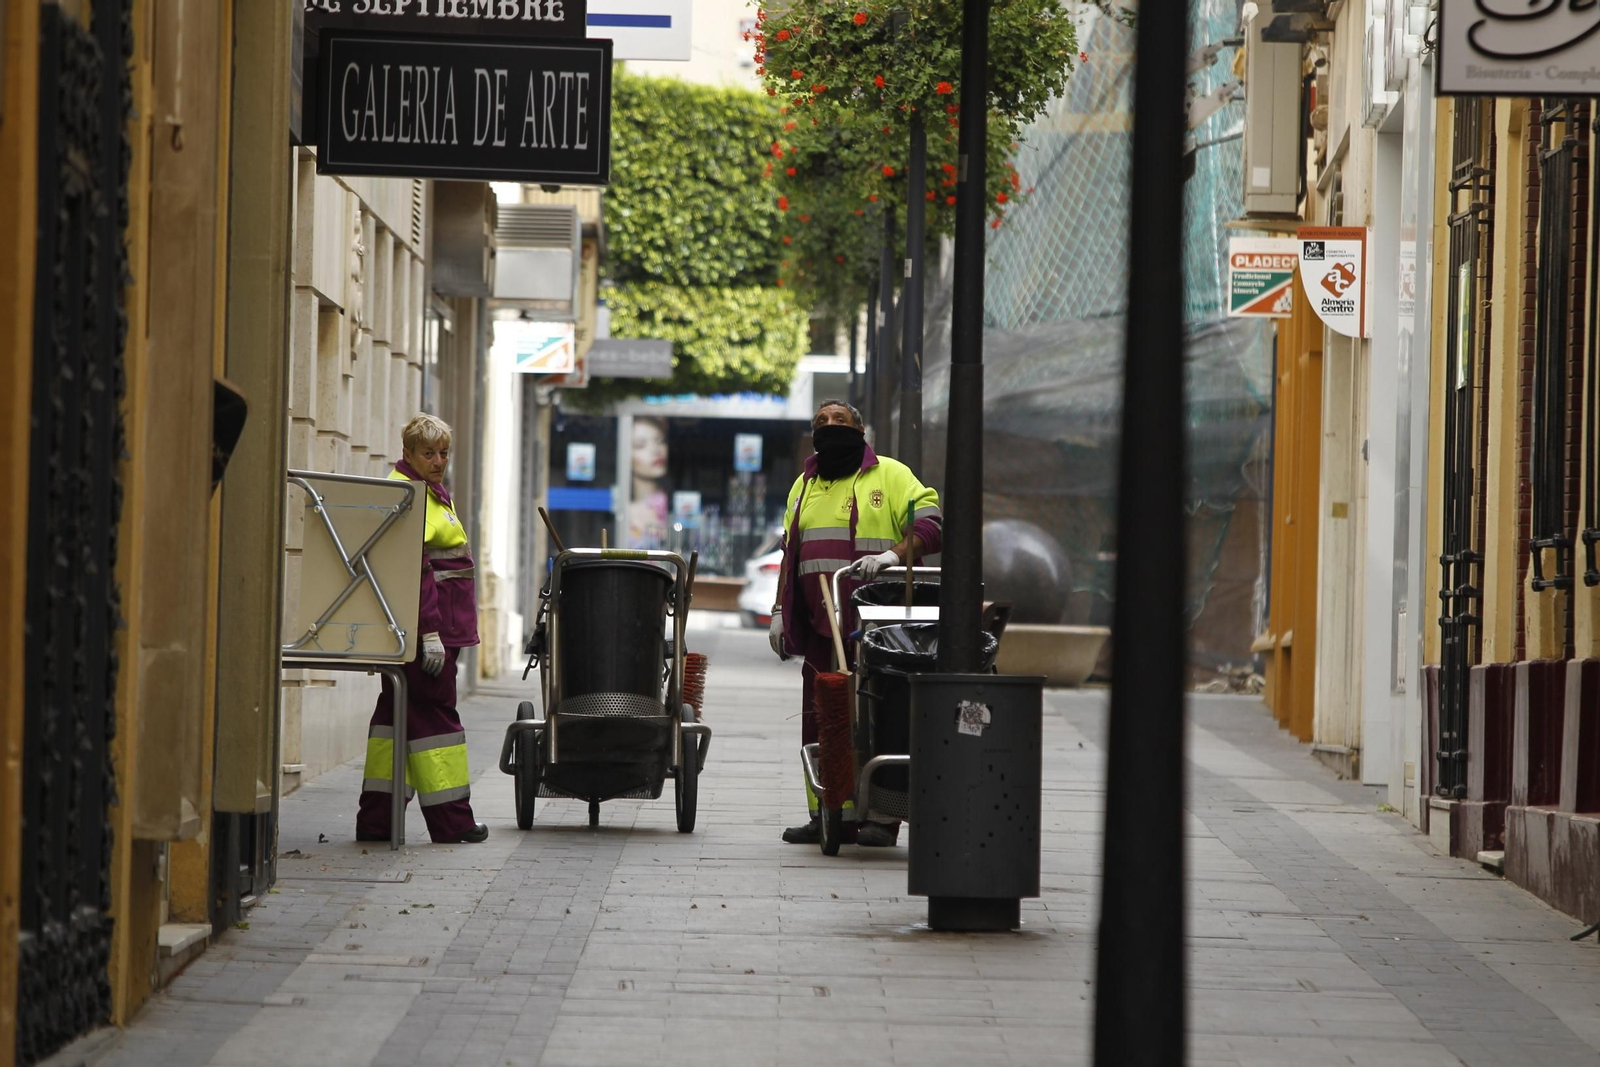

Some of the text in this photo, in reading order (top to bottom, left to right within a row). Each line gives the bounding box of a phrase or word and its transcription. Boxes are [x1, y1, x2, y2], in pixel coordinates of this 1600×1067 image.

[341, 61, 590, 151] GALERIA DE ARTE
[1321, 304, 1354, 313] centro
